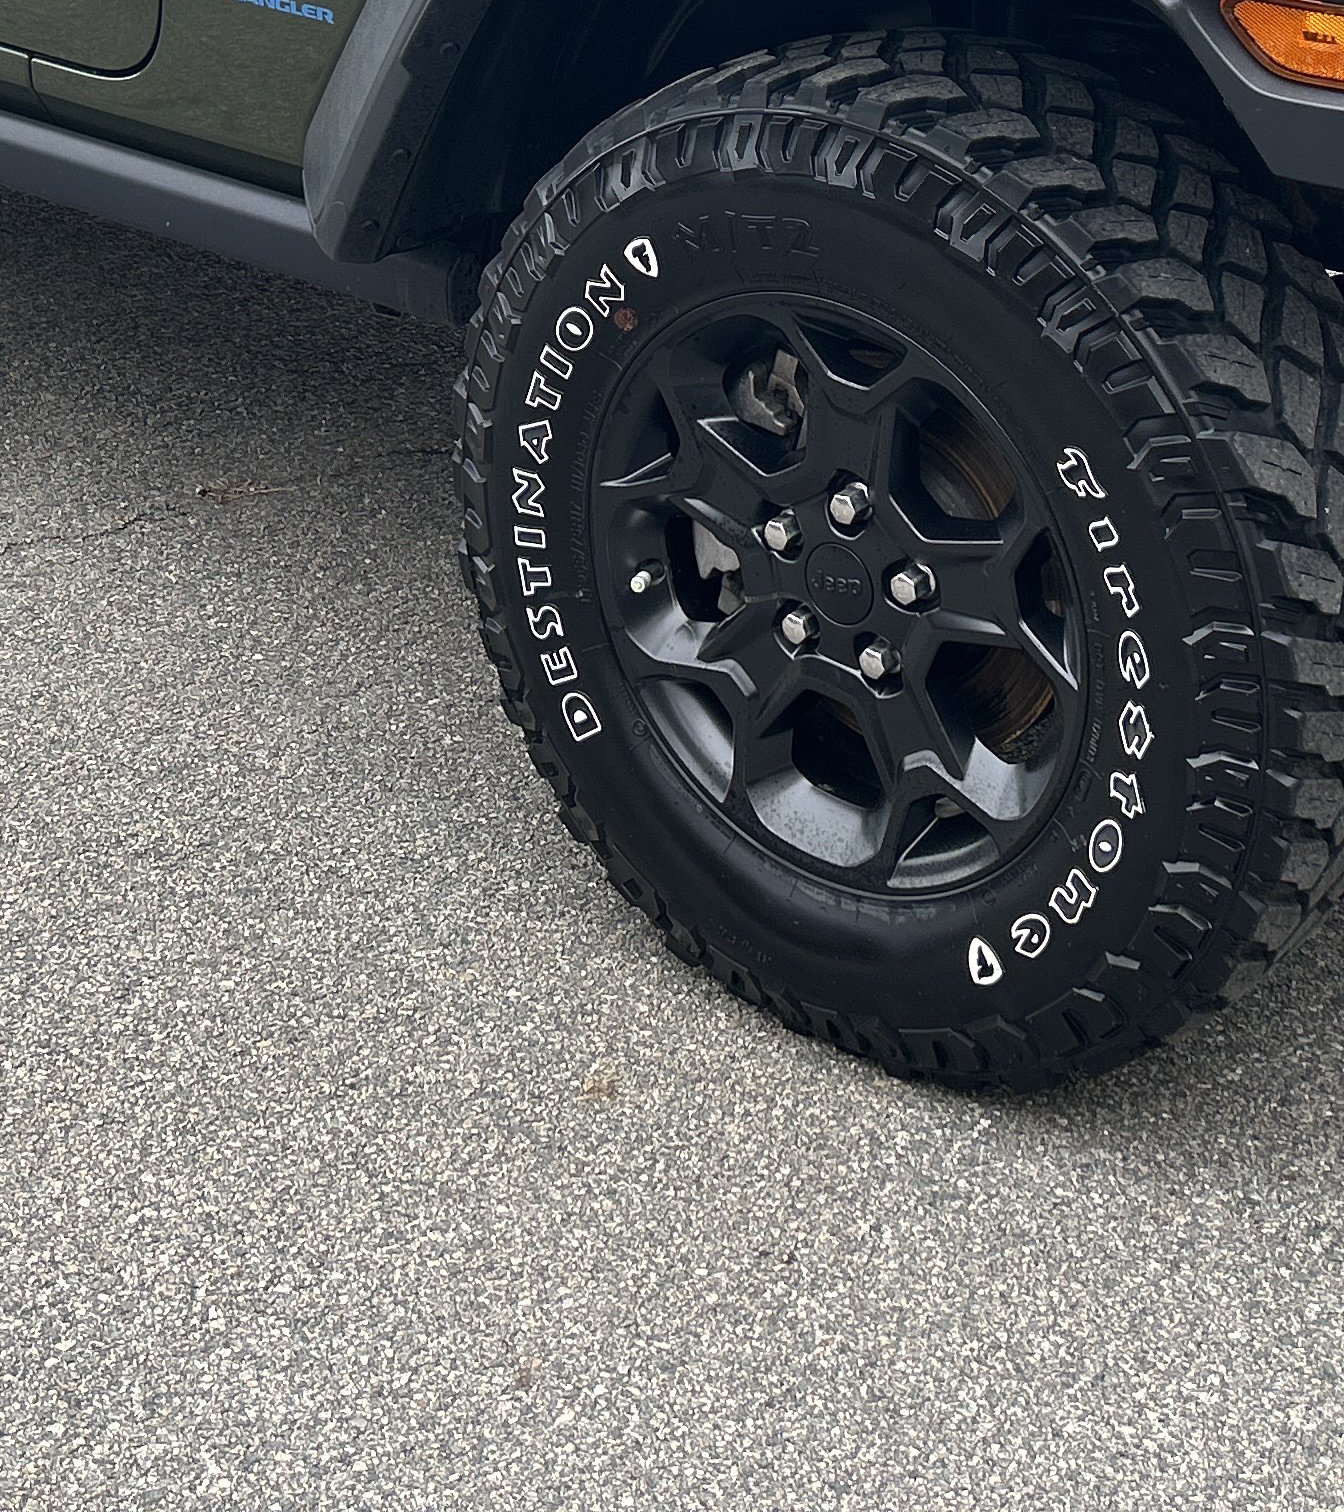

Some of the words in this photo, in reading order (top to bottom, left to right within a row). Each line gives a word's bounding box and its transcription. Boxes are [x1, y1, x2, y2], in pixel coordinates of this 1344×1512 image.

[512, 264, 626, 743] DESTINATION
[809, 568, 864, 599] Jeep
[1011, 446, 1154, 958] Firestone
